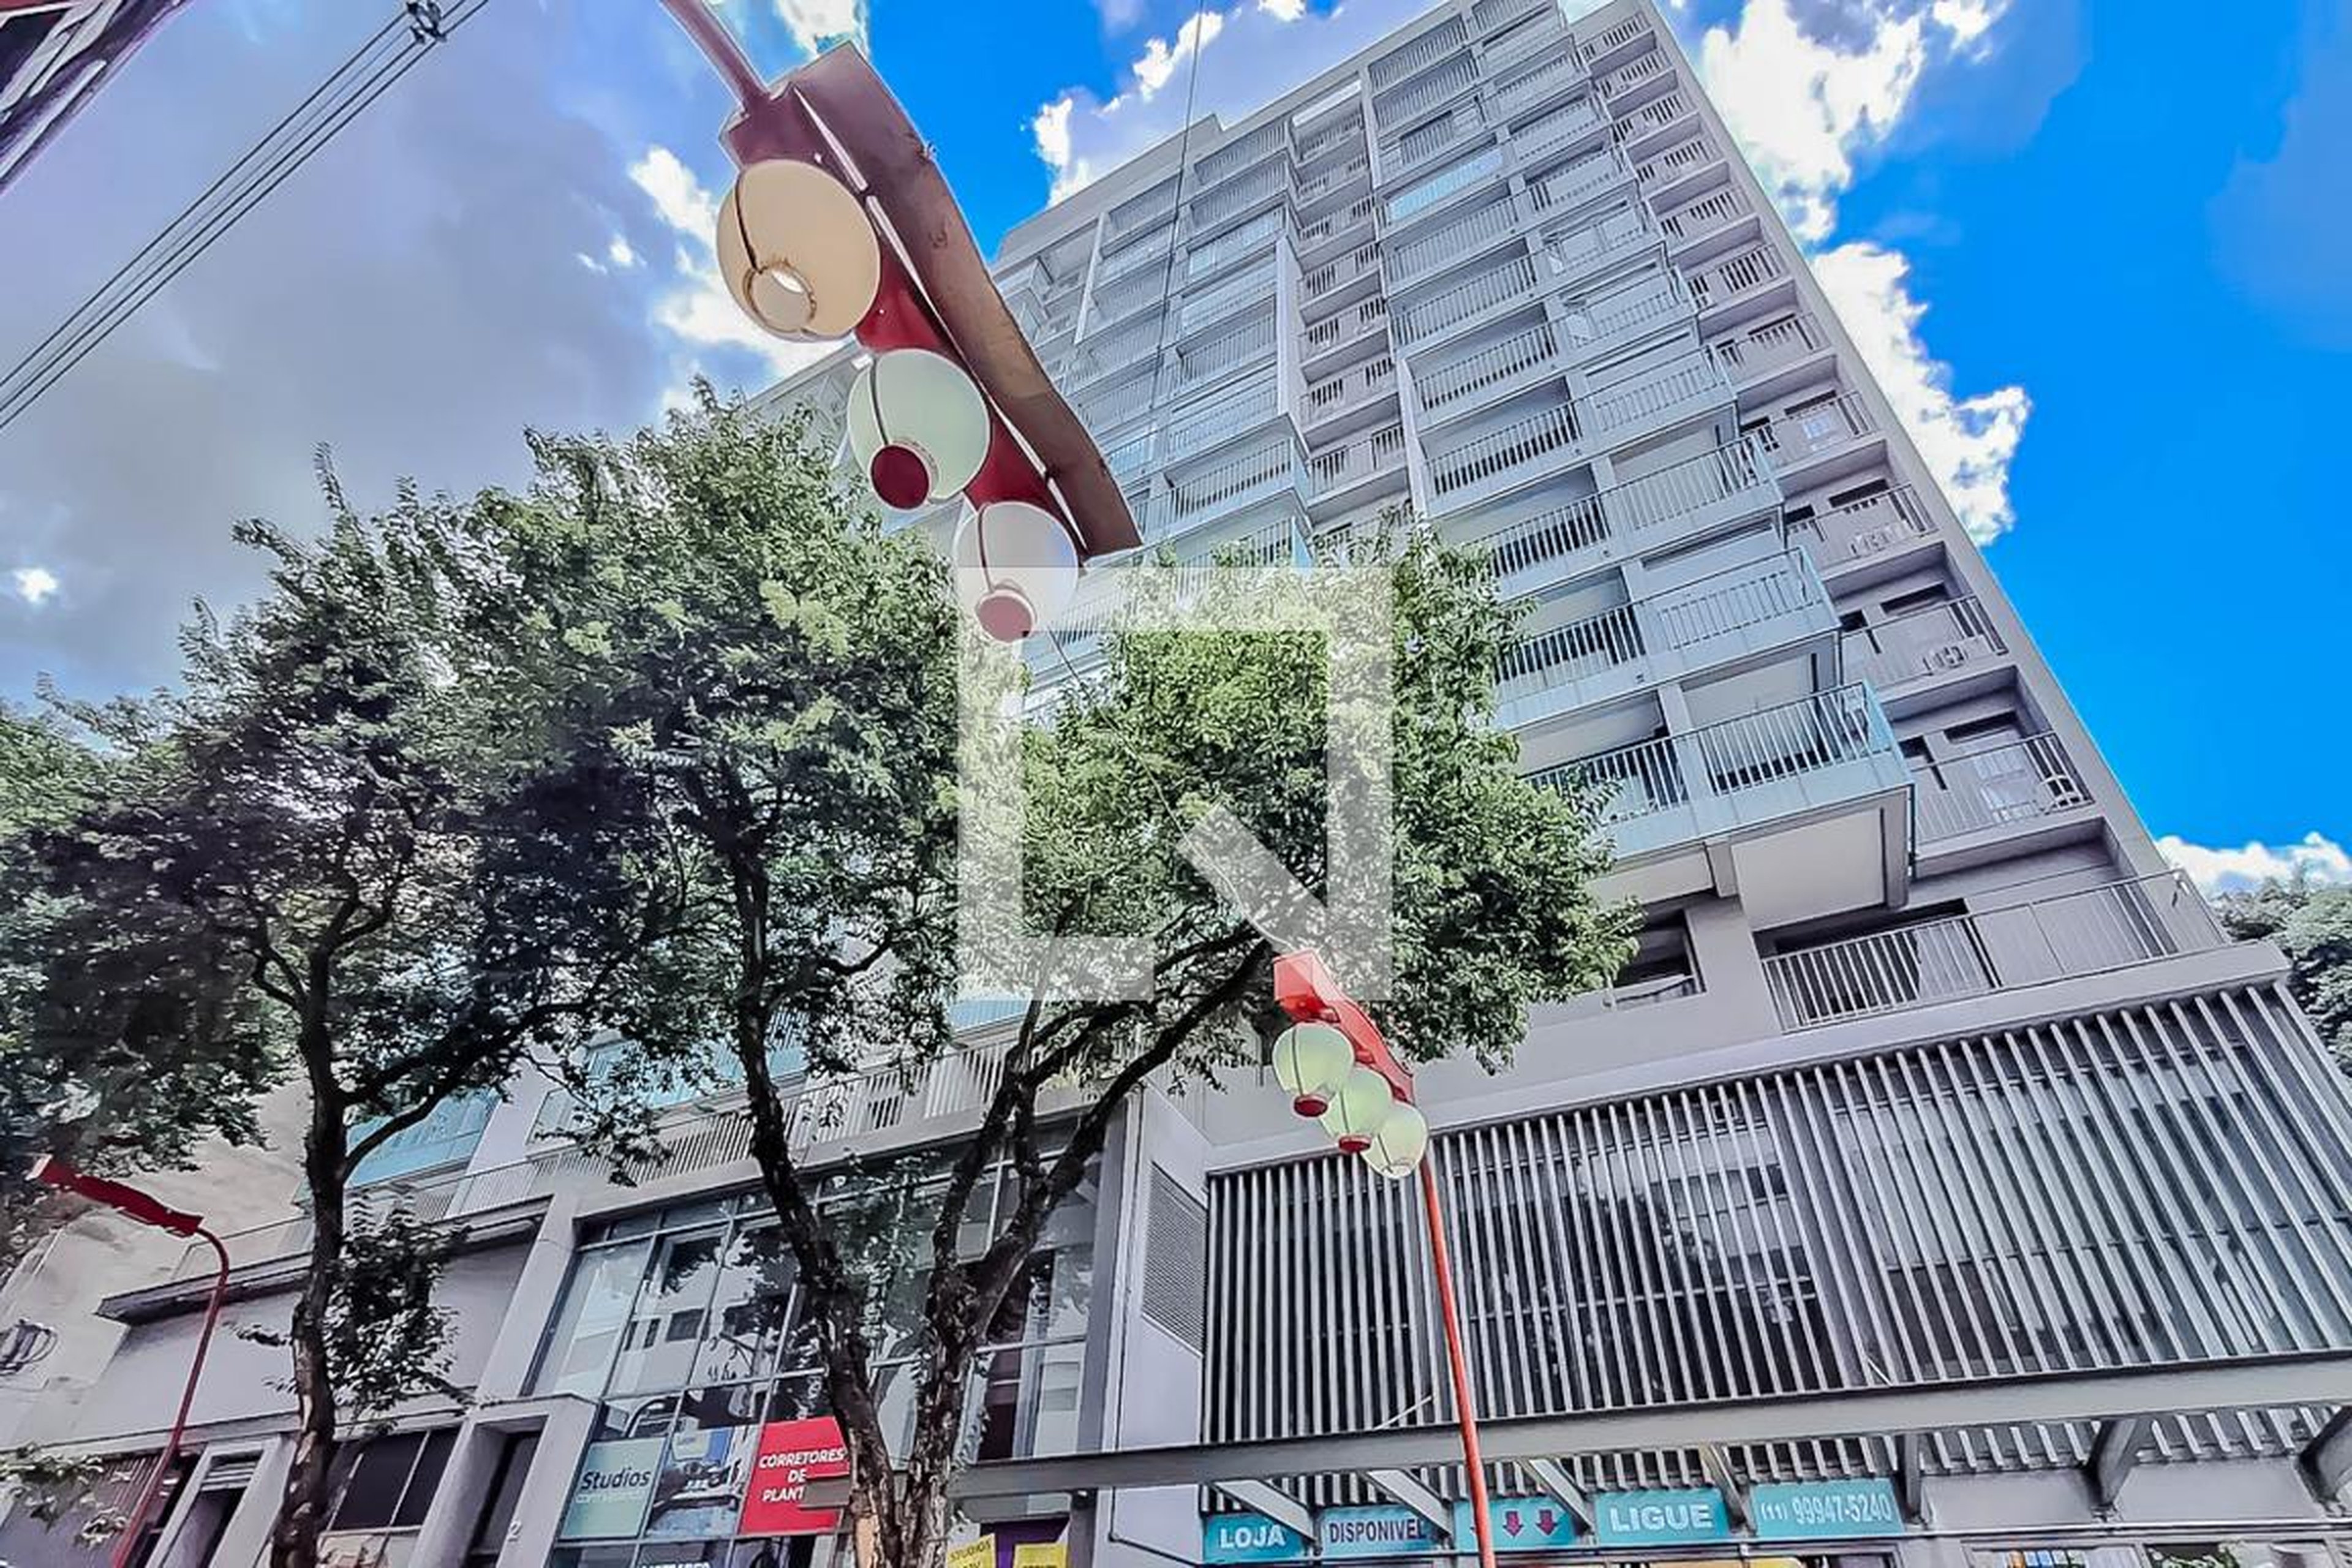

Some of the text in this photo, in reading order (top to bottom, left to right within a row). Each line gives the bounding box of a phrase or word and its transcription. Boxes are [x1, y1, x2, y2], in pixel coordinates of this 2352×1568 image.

[759, 1448, 847, 1468] CORRETORES
[581, 1466, 651, 1490] Studios
[788, 1468, 807, 1483] DE
[762, 1486, 805, 1502] PLANT
[1610, 1504, 1713, 1532] LIGUE
[1760, 1493, 1892, 1524] (11) 99947-5240
[1219, 1525, 1286, 1549] LOJA
[1329, 1519, 1427, 1542] DISPONIVEL
